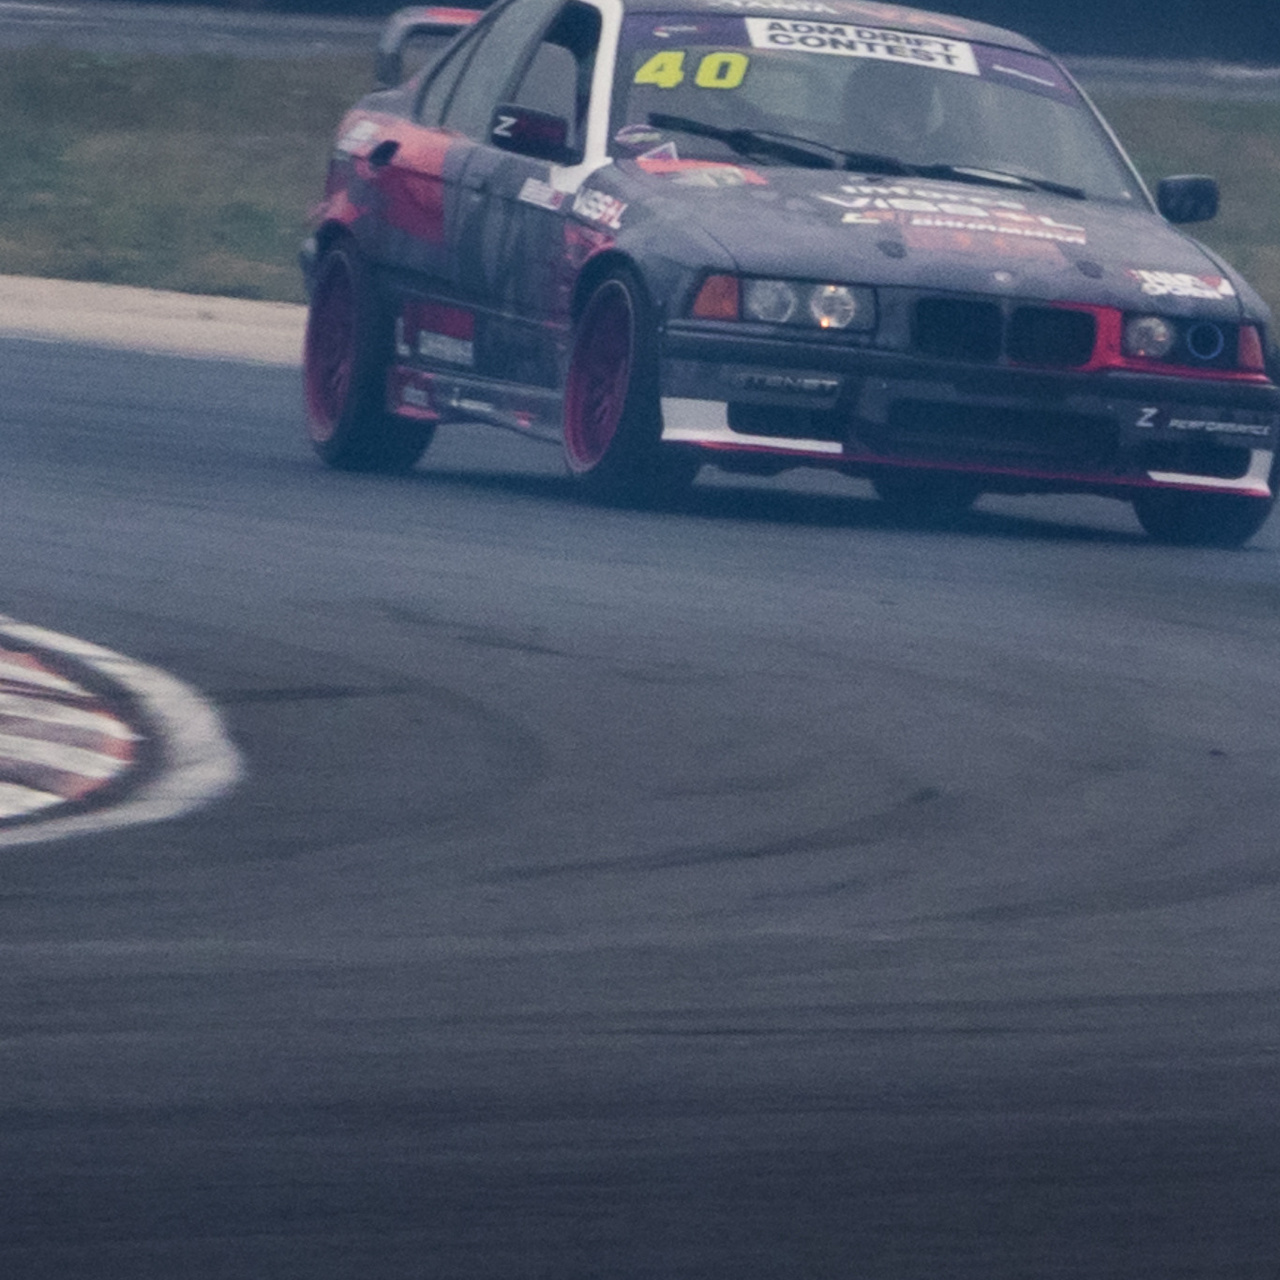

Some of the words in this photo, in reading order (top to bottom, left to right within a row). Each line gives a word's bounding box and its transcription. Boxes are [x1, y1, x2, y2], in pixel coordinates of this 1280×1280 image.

[767, 21, 846, 38] ADM
[857, 28, 956, 53] DRIFT
[767, 33, 958, 66] CONTEST
[634, 50, 749, 89] 40
